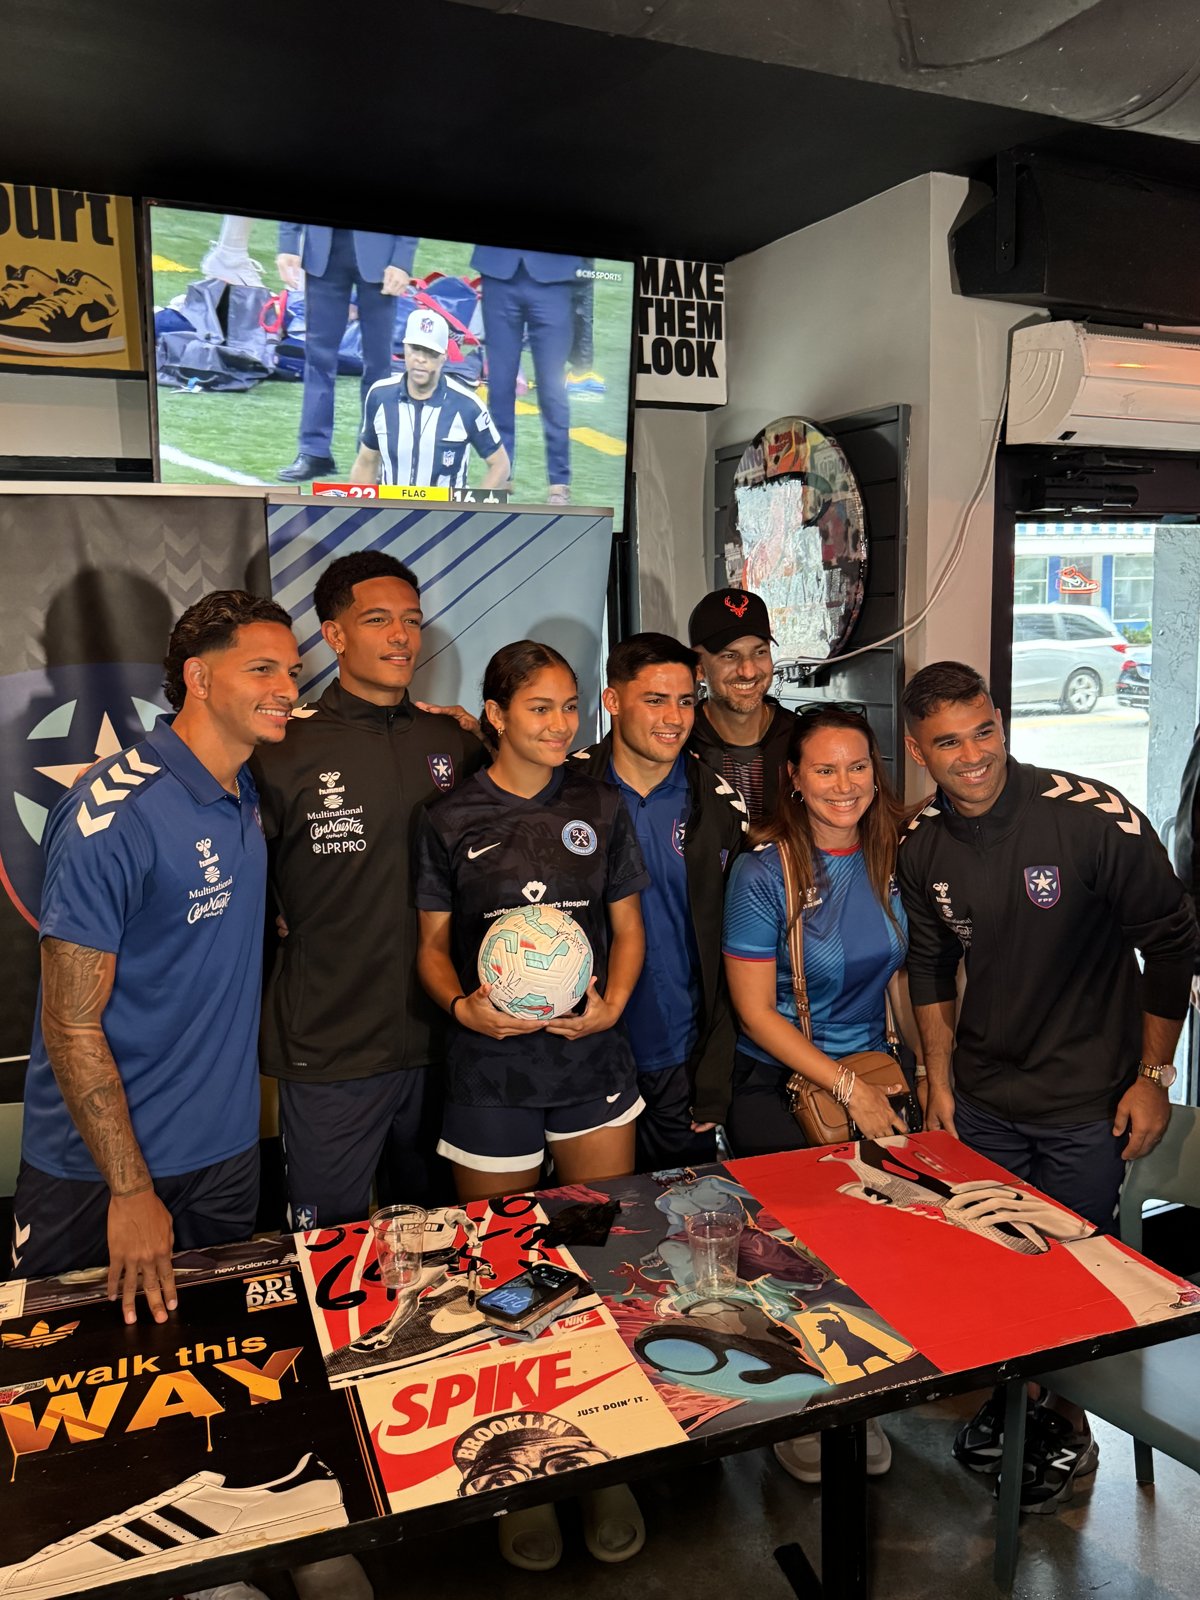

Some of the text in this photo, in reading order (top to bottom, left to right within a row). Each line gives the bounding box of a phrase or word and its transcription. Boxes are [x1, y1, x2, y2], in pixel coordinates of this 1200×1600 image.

[0, 184, 114, 246] urt
[640, 257, 724, 302] MAKE
[639, 297, 723, 340] THEM
[637, 336, 719, 378] LOOK
[402, 489, 427, 498] FLAG
[307, 805, 363, 820] Multinational
[342, 839, 366, 853] PRO
[189, 875, 232, 899] Multinational
[214, 1259, 279, 1275] new balance
[246, 1275, 293, 1295] ADI
[246, 1287, 297, 1308] DAS
[564, 1314, 590, 1328] NIKE
[46, 1354, 161, 1393] walk
[175, 1336, 268, 1367] this
[0, 1346, 304, 1462] WAY
[386, 1351, 572, 1436] SPIKE
[577, 1407, 599, 1417] JUST
[603, 1398, 631, 1411] DOIN'
[457, 1414, 573, 1461] BROOKLYN
